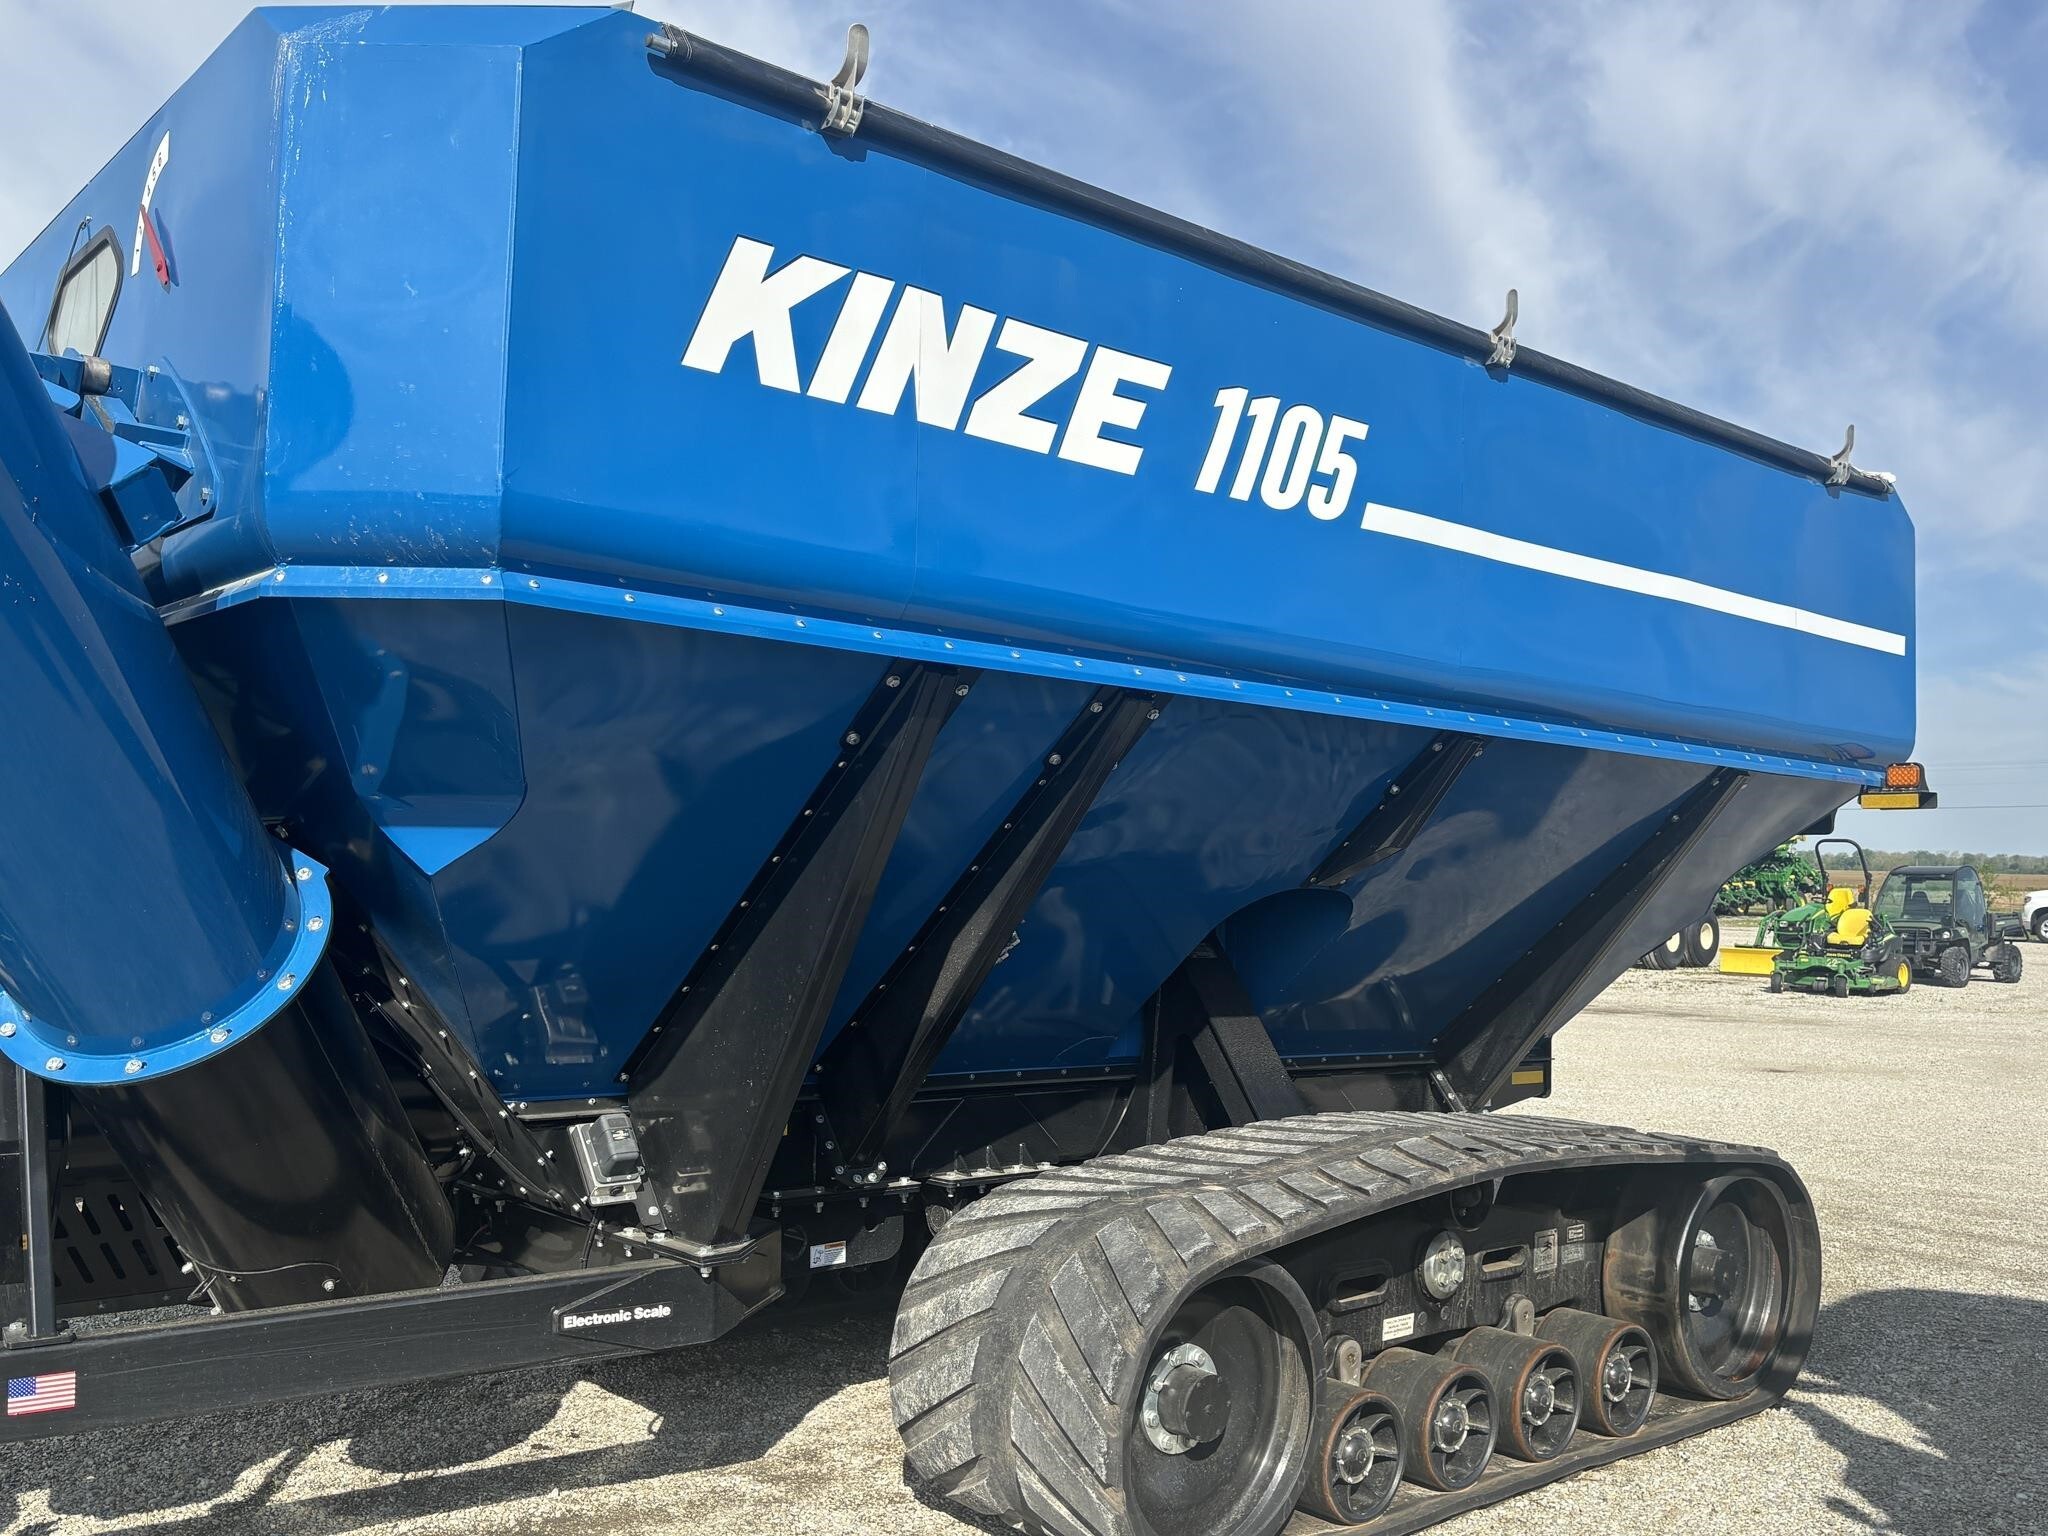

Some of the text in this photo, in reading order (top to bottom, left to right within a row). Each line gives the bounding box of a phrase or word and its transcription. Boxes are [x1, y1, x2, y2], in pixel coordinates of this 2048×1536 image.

[681, 235, 1369, 520] KINZE 1105
[563, 1304, 672, 1329] Electronic Scale
